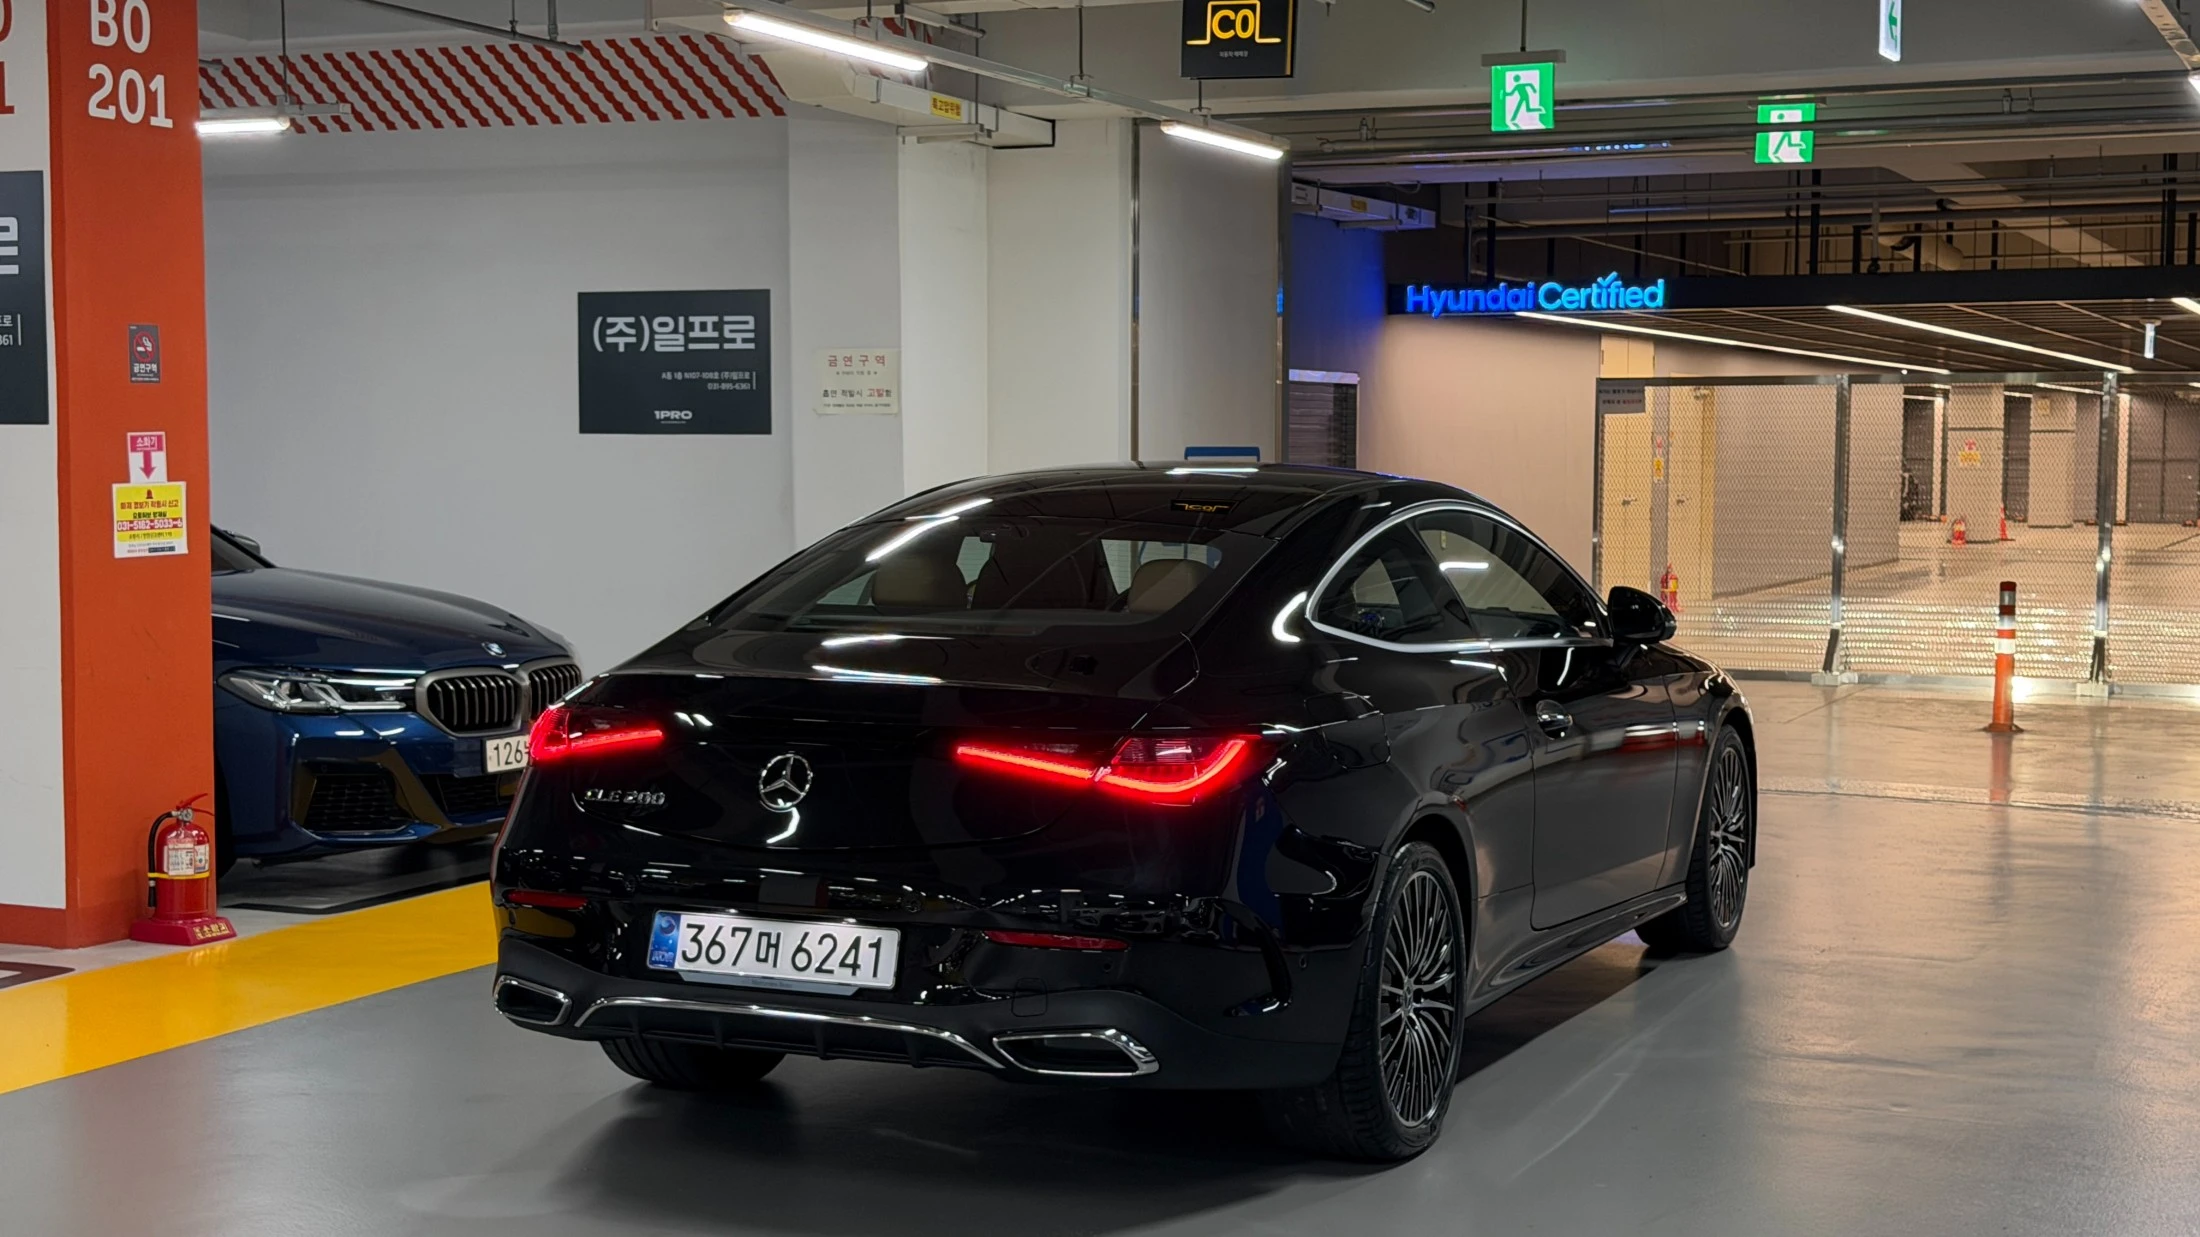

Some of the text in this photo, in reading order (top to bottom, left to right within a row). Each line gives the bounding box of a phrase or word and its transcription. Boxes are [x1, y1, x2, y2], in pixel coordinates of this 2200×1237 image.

[88, 63, 173, 128] 201
[1406, 272, 1664, 318] Hyundai Certified
[593, 315, 755, 352] (주)일프로
[133, 362, 158, 374] 금연구역
[654, 410, 692, 420] 1PRO
[136, 436, 158, 448] 소화기
[584, 788, 666, 805] CLE 200
[791, 931, 882, 978] 6241
